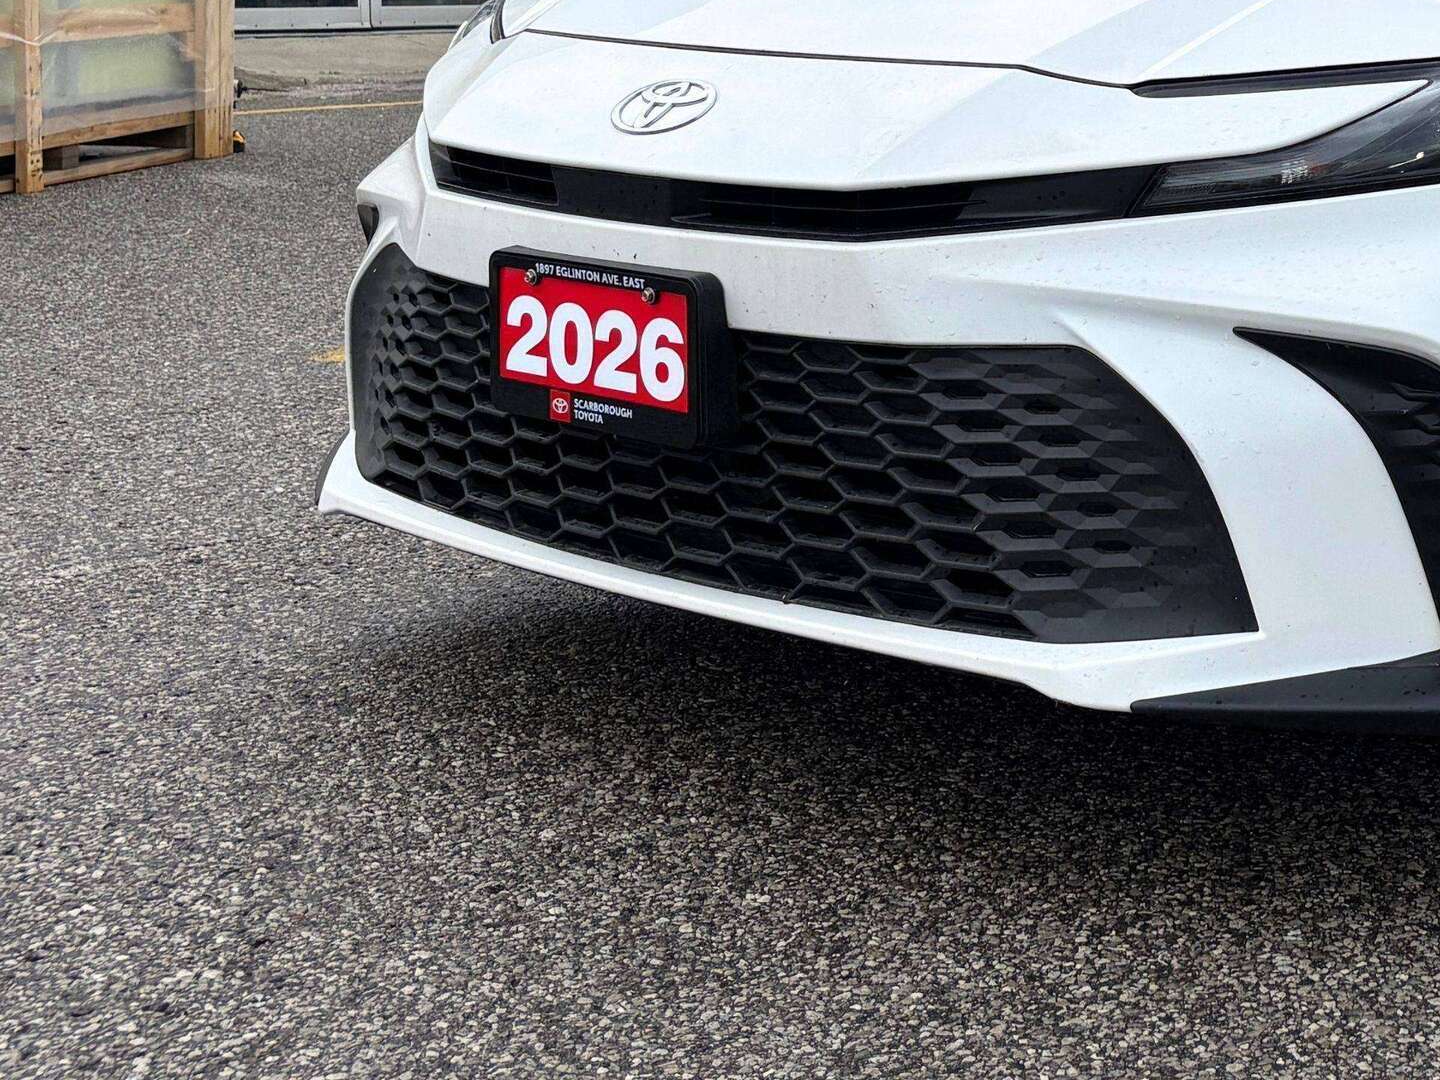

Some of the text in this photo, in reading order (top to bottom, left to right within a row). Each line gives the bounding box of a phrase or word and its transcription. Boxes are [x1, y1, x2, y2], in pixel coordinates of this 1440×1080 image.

[535, 262, 645, 290] 1897 EGLINTON AVE. EAST
[505, 295, 685, 402] 2026
[573, 398, 633, 419] SCARBOROUGH
[573, 409, 604, 424] TOYOTA
